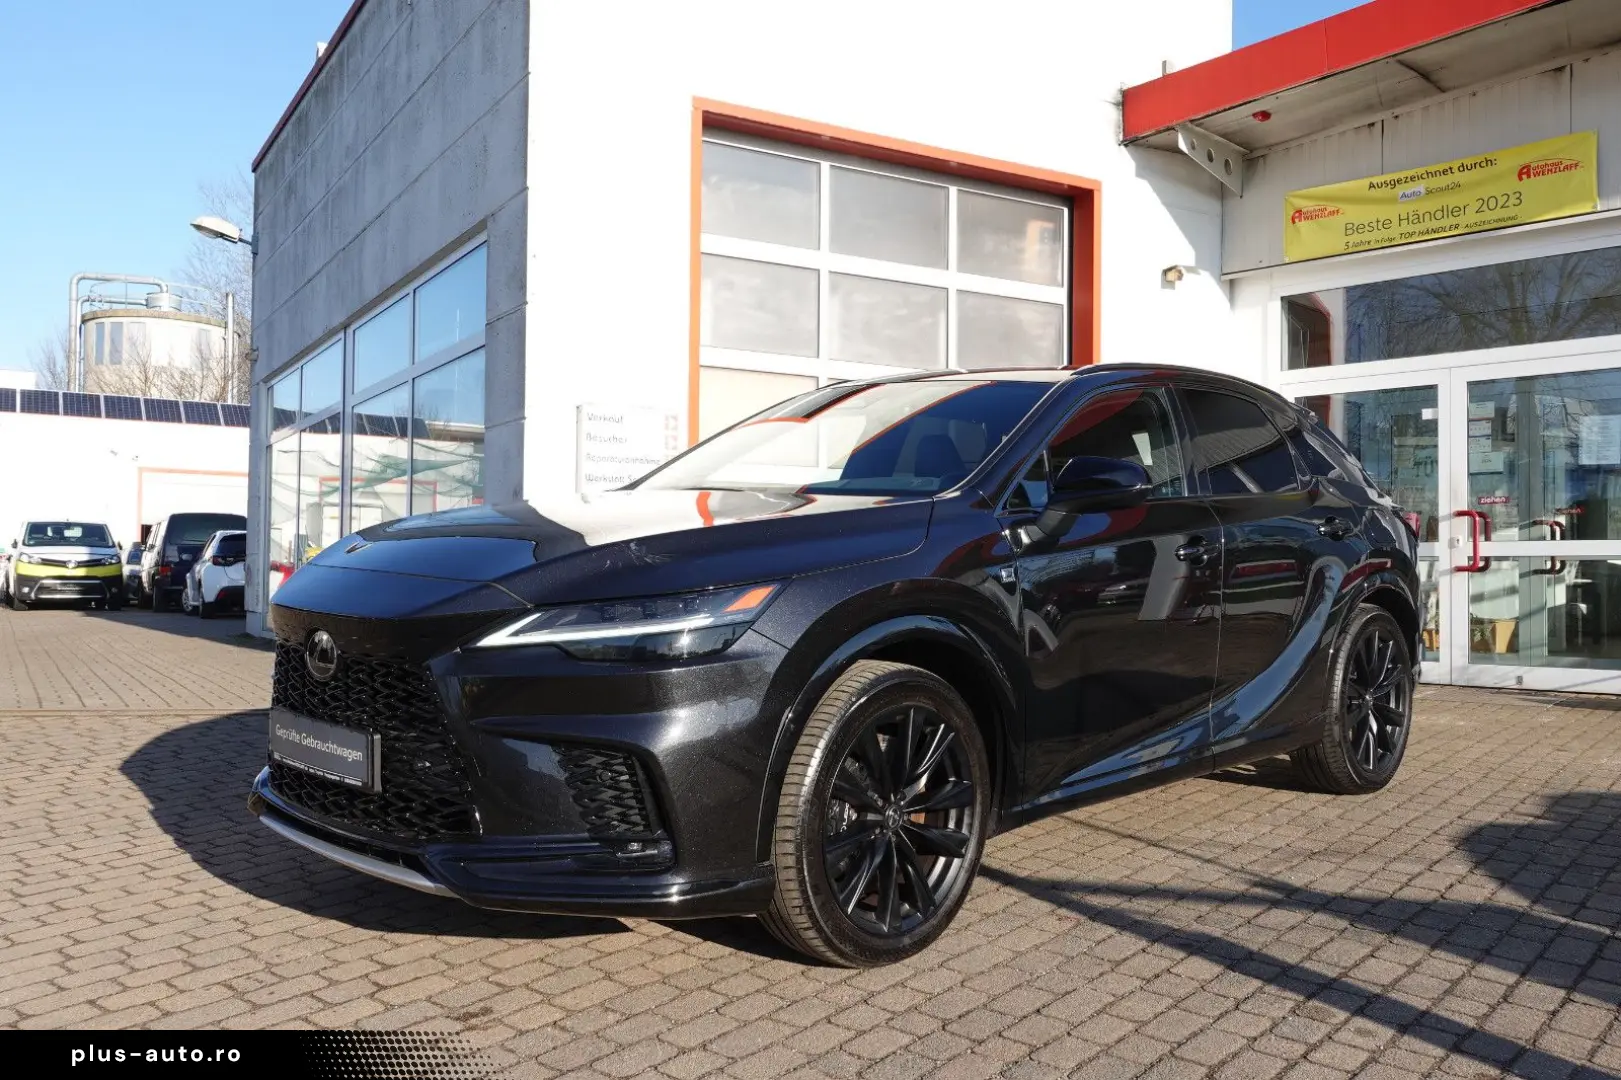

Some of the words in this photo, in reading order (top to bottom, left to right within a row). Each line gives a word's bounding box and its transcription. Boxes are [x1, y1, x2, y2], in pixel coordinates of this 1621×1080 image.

[1368, 166, 1455, 191] Ausgezeichnet
[1457, 157, 1497, 173] durch:
[1517, 160, 1563, 182] Autohaus
[1532, 162, 1580, 178] WENZLAFF
[1400, 189, 1421, 200] Auto
[1425, 181, 1461, 196] Scout24
[1344, 217, 1393, 237] Beste
[1398, 203, 1470, 228] Händler
[1475, 190, 1523, 214] 2023
[1344, 241, 1351, 251] 5
[1398, 230, 1417, 240] TOP
[275, 724, 300, 743] Geprüfte
[301, 733, 363, 762] Gebrauchtwagen
